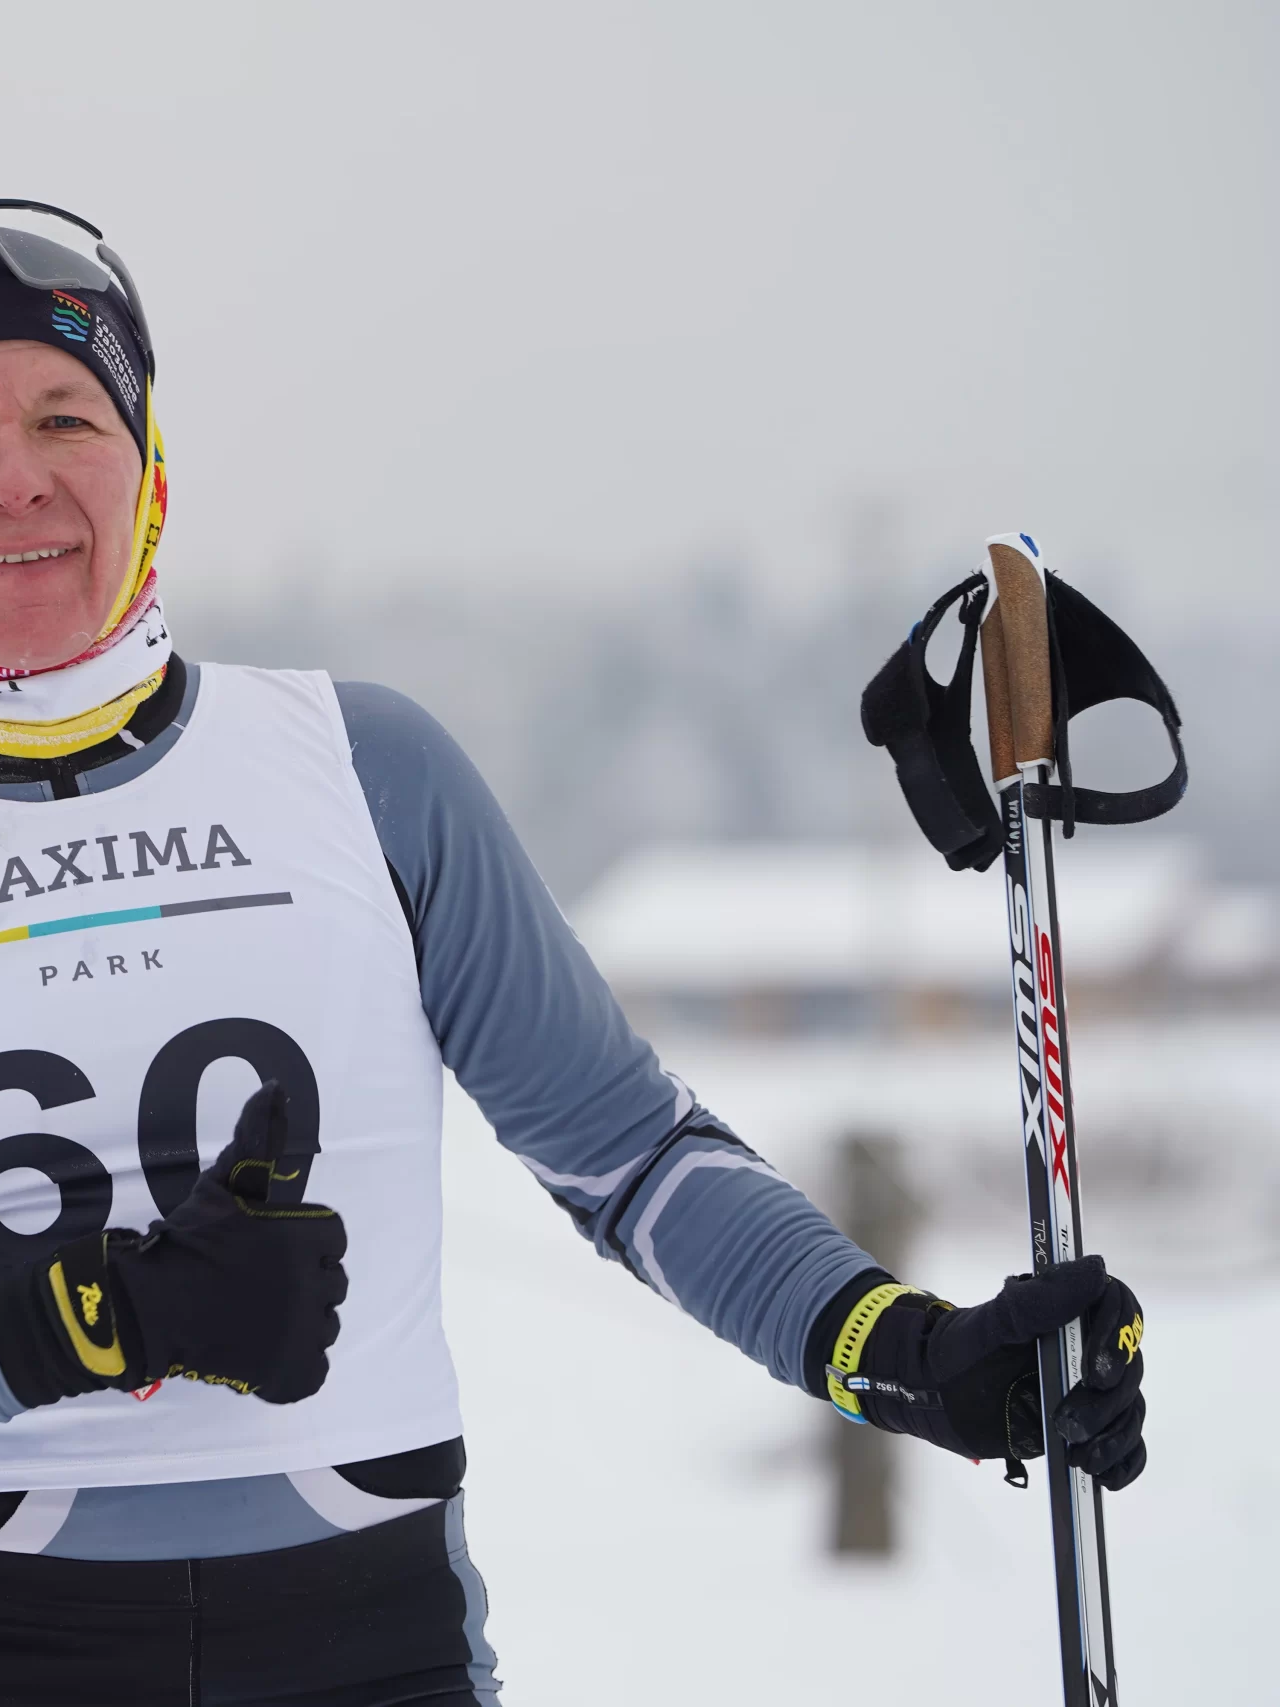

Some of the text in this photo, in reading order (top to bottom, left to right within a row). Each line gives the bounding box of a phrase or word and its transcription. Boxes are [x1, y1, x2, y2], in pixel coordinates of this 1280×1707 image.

[95, 324, 137, 403] Заозерье
[39, 949, 163, 987] PARK
[1007, 873, 1047, 1167] SWIX
[1034, 923, 1071, 1200] SWIX
[876, 1381, 898, 1392] 1952
